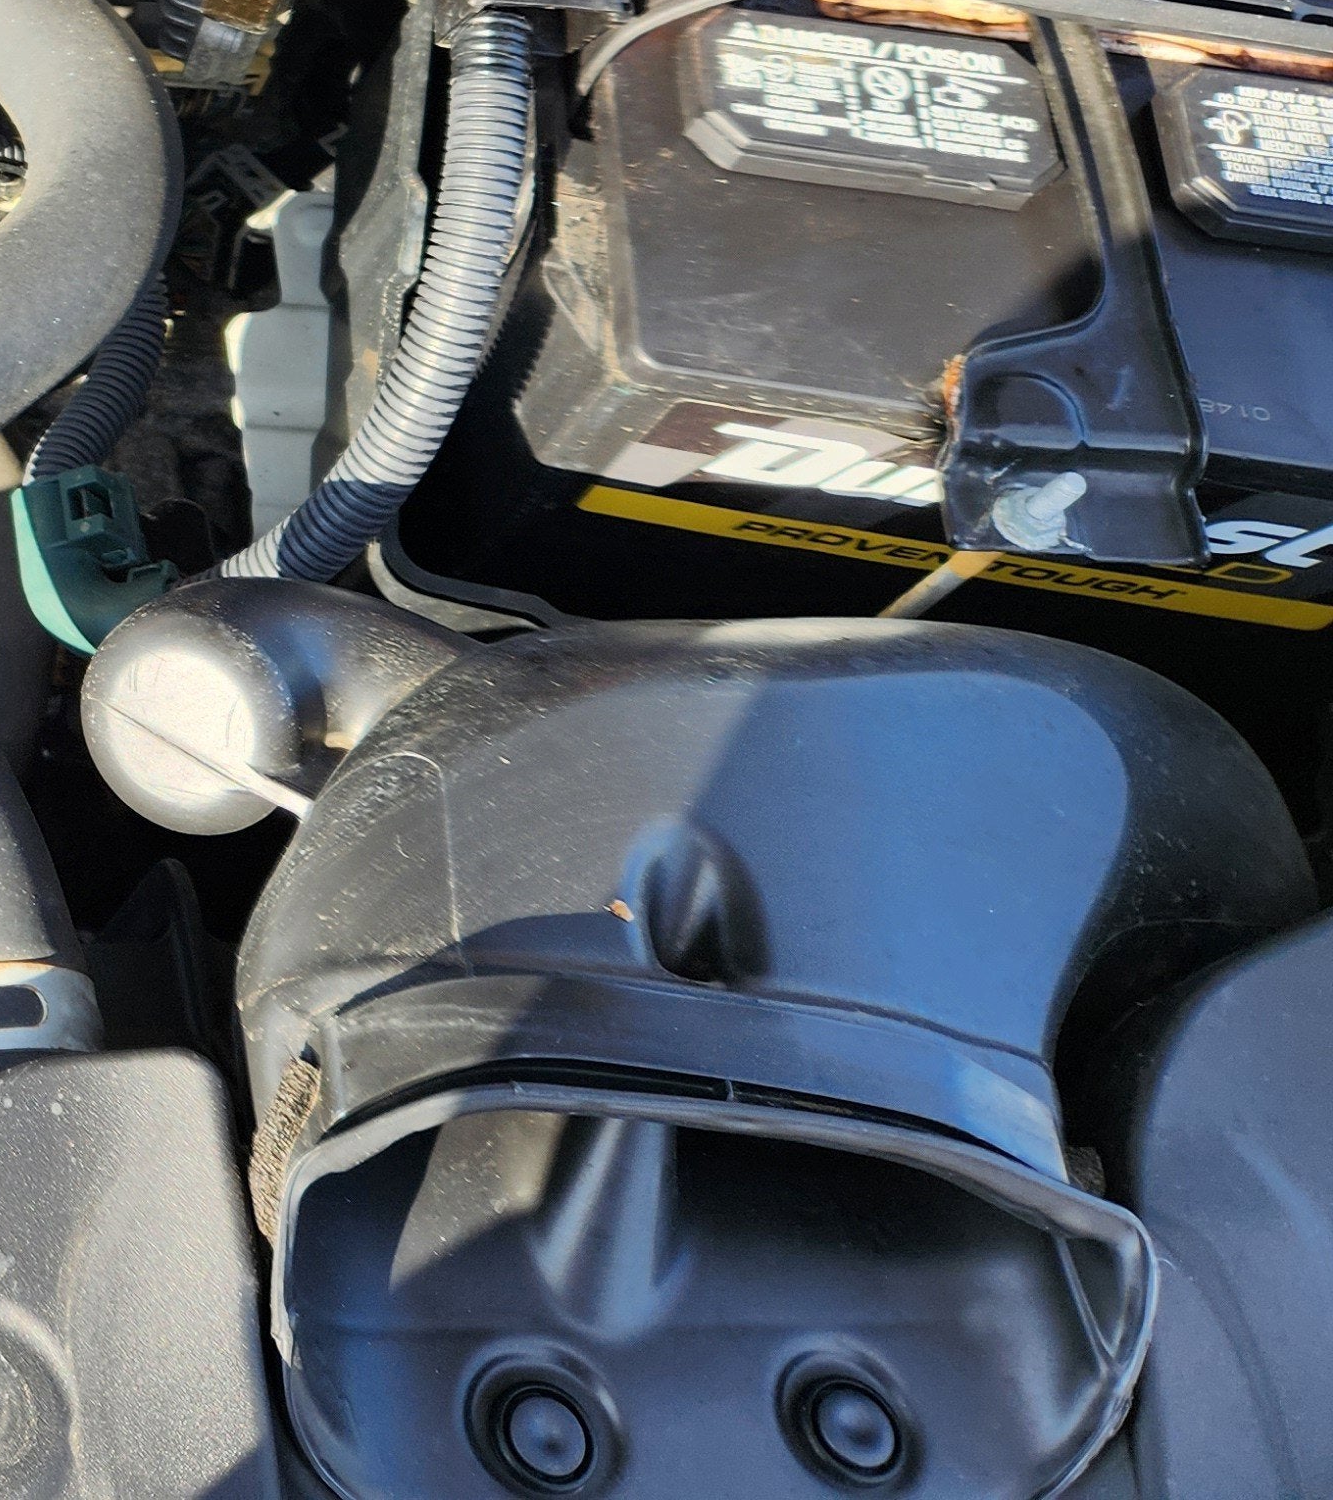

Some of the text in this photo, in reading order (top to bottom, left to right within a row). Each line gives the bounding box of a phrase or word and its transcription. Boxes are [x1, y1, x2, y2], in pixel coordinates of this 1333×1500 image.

[896, 42, 1006, 75] POISON
[1213, 92, 1234, 104] DO
[1251, 112, 1287, 130] FLUSH
[1288, 117, 1321, 136] EYES
[733, 520, 950, 565] PROVEN
[987, 560, 1181, 600] TOUGH
